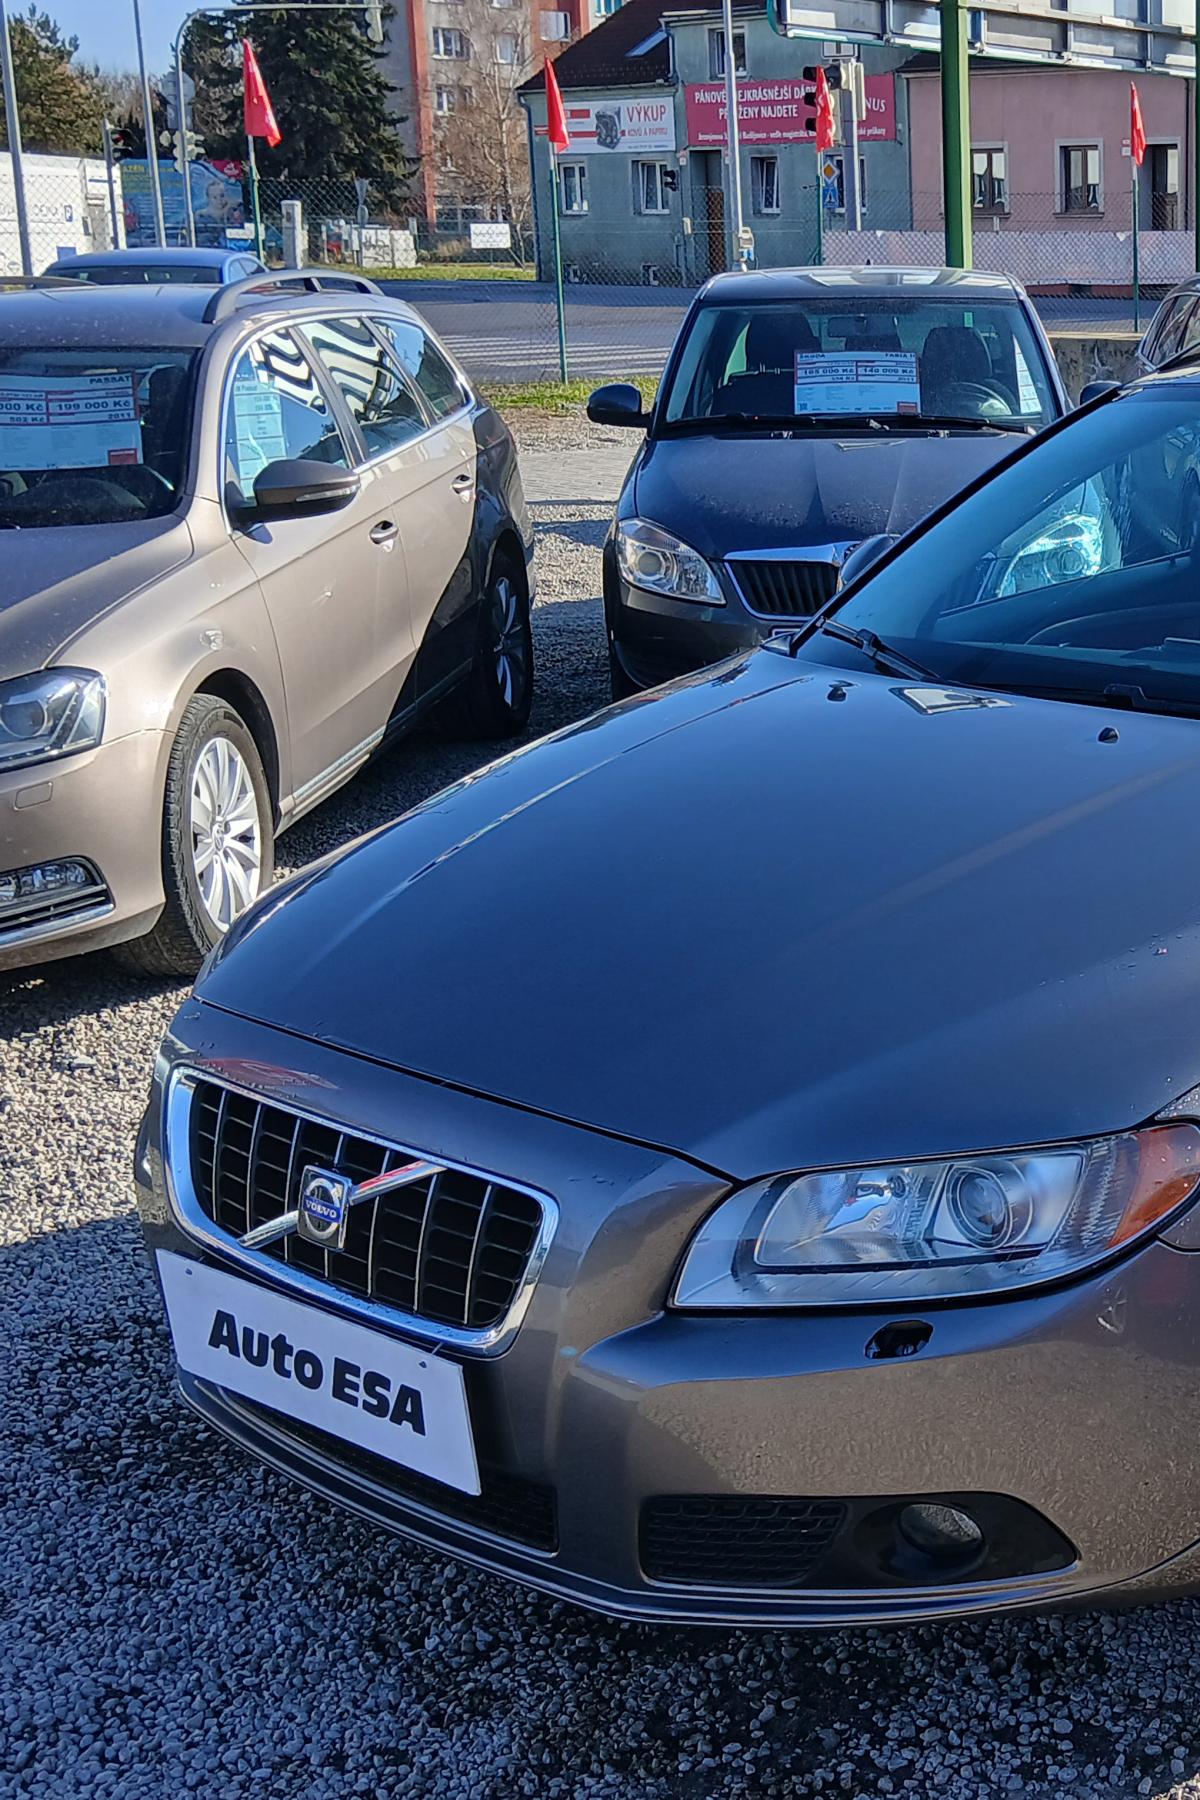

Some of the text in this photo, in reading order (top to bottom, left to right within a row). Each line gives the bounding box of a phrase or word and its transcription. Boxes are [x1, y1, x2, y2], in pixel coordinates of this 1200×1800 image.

[737, 86, 792, 103] EJKRÁSNĚJŠÍ
[626, 102, 667, 123] VÝKUP
[738, 104, 759, 119] ŽENY
[761, 105, 798, 118] NAJDETE
[865, 96, 886, 113] NUS
[89, 375, 131, 385] PASSAT
[25, 403, 44, 412] Kč
[56, 399, 131, 411] 199 000 Kč
[304, 1199, 338, 1219] VOLVO
[207, 1308, 427, 1437] Auto ESA
